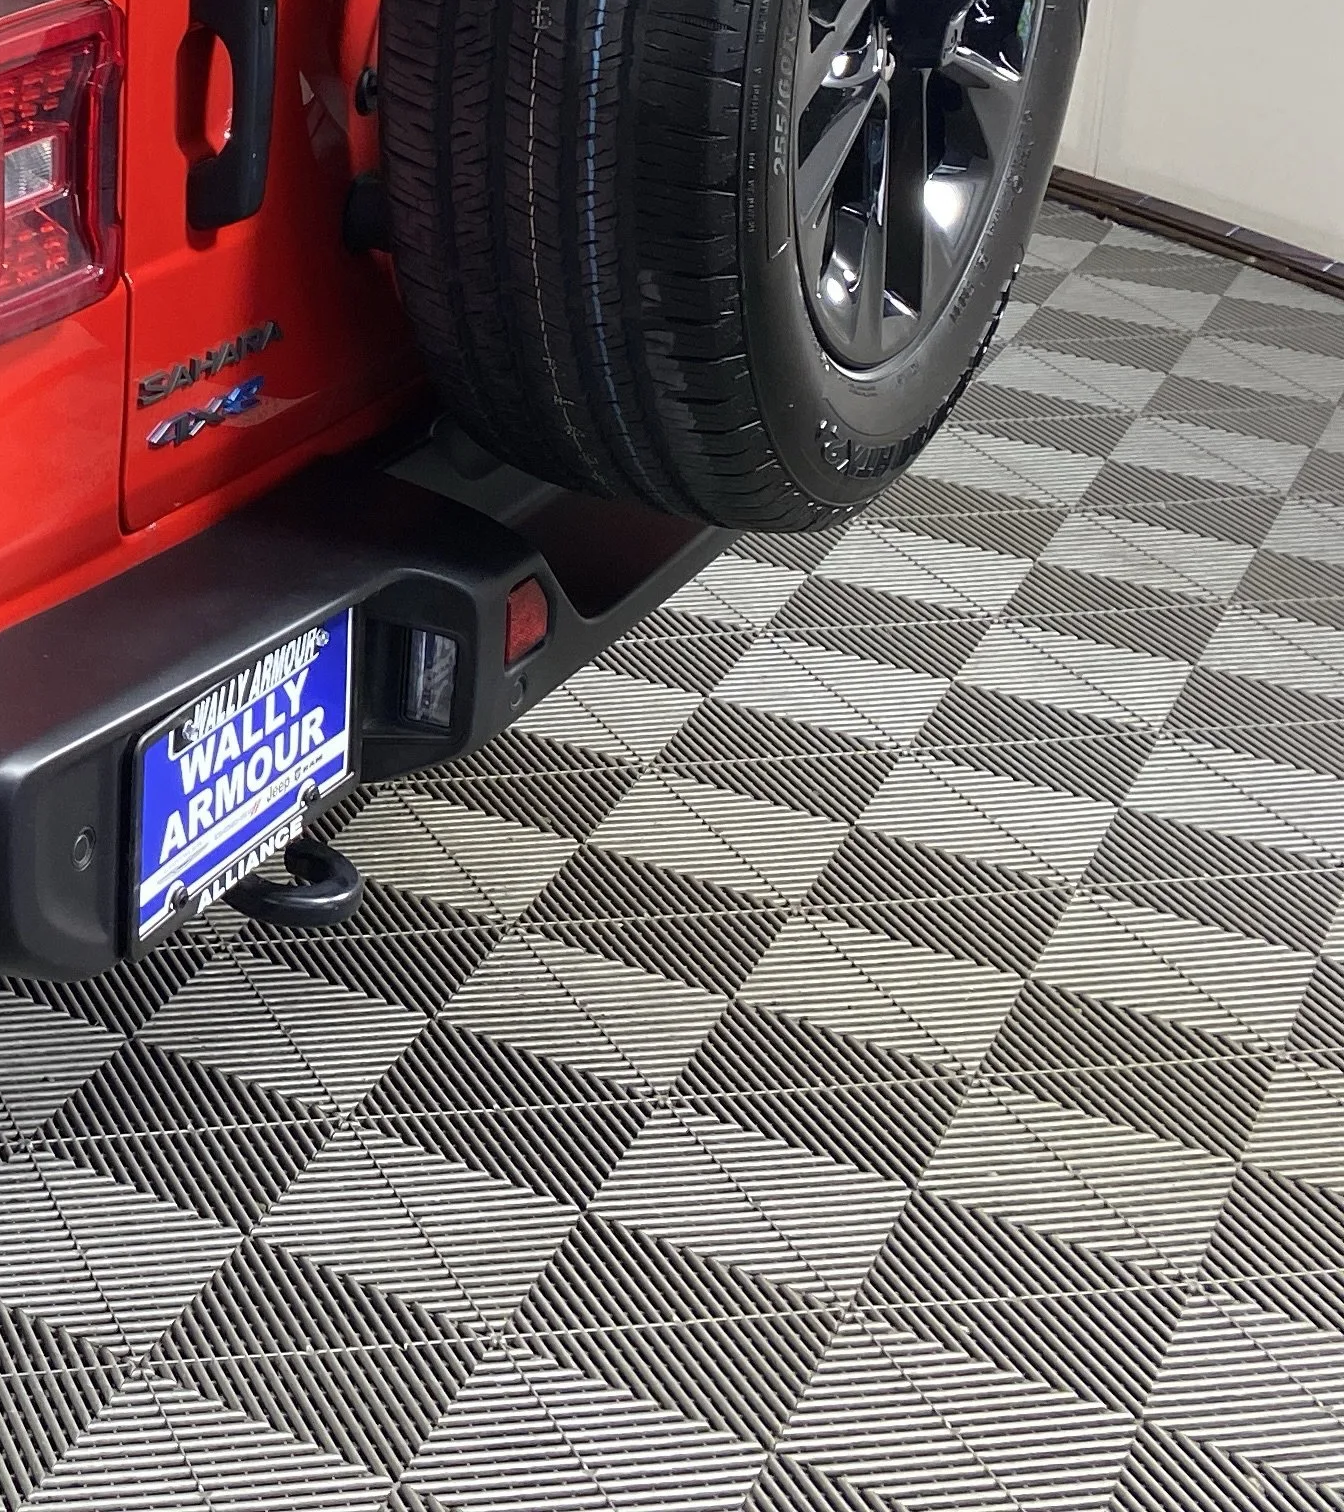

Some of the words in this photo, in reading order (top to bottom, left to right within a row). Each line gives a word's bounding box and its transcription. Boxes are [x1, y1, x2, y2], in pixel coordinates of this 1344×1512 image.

[137, 320, 284, 409] SAHARA
[180, 667, 309, 795] WALLY
[194, 668, 252, 735] WALLY
[249, 627, 319, 695] ARMOUR
[159, 706, 325, 865] ARMOUR
[266, 776, 291, 803] Jeep
[196, 814, 304, 914] ALLIANCE
